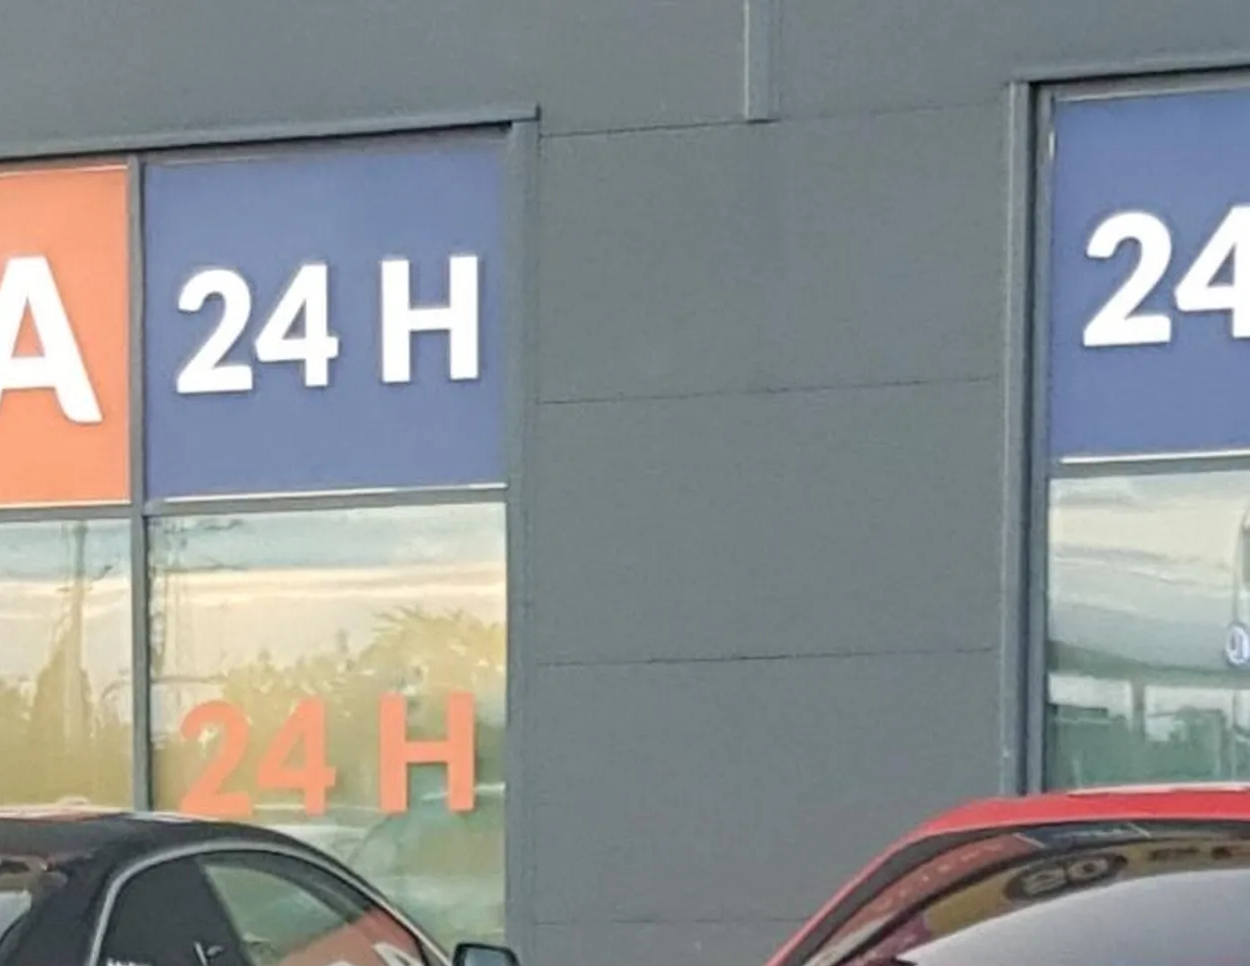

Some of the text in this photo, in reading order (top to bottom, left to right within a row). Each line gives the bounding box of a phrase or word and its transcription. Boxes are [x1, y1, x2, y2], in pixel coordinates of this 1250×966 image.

[176, 263, 339, 394] 24
[381, 255, 479, 383] H
[1083, 206, 1250, 347] 24
[180, 692, 475, 817] 24 H
